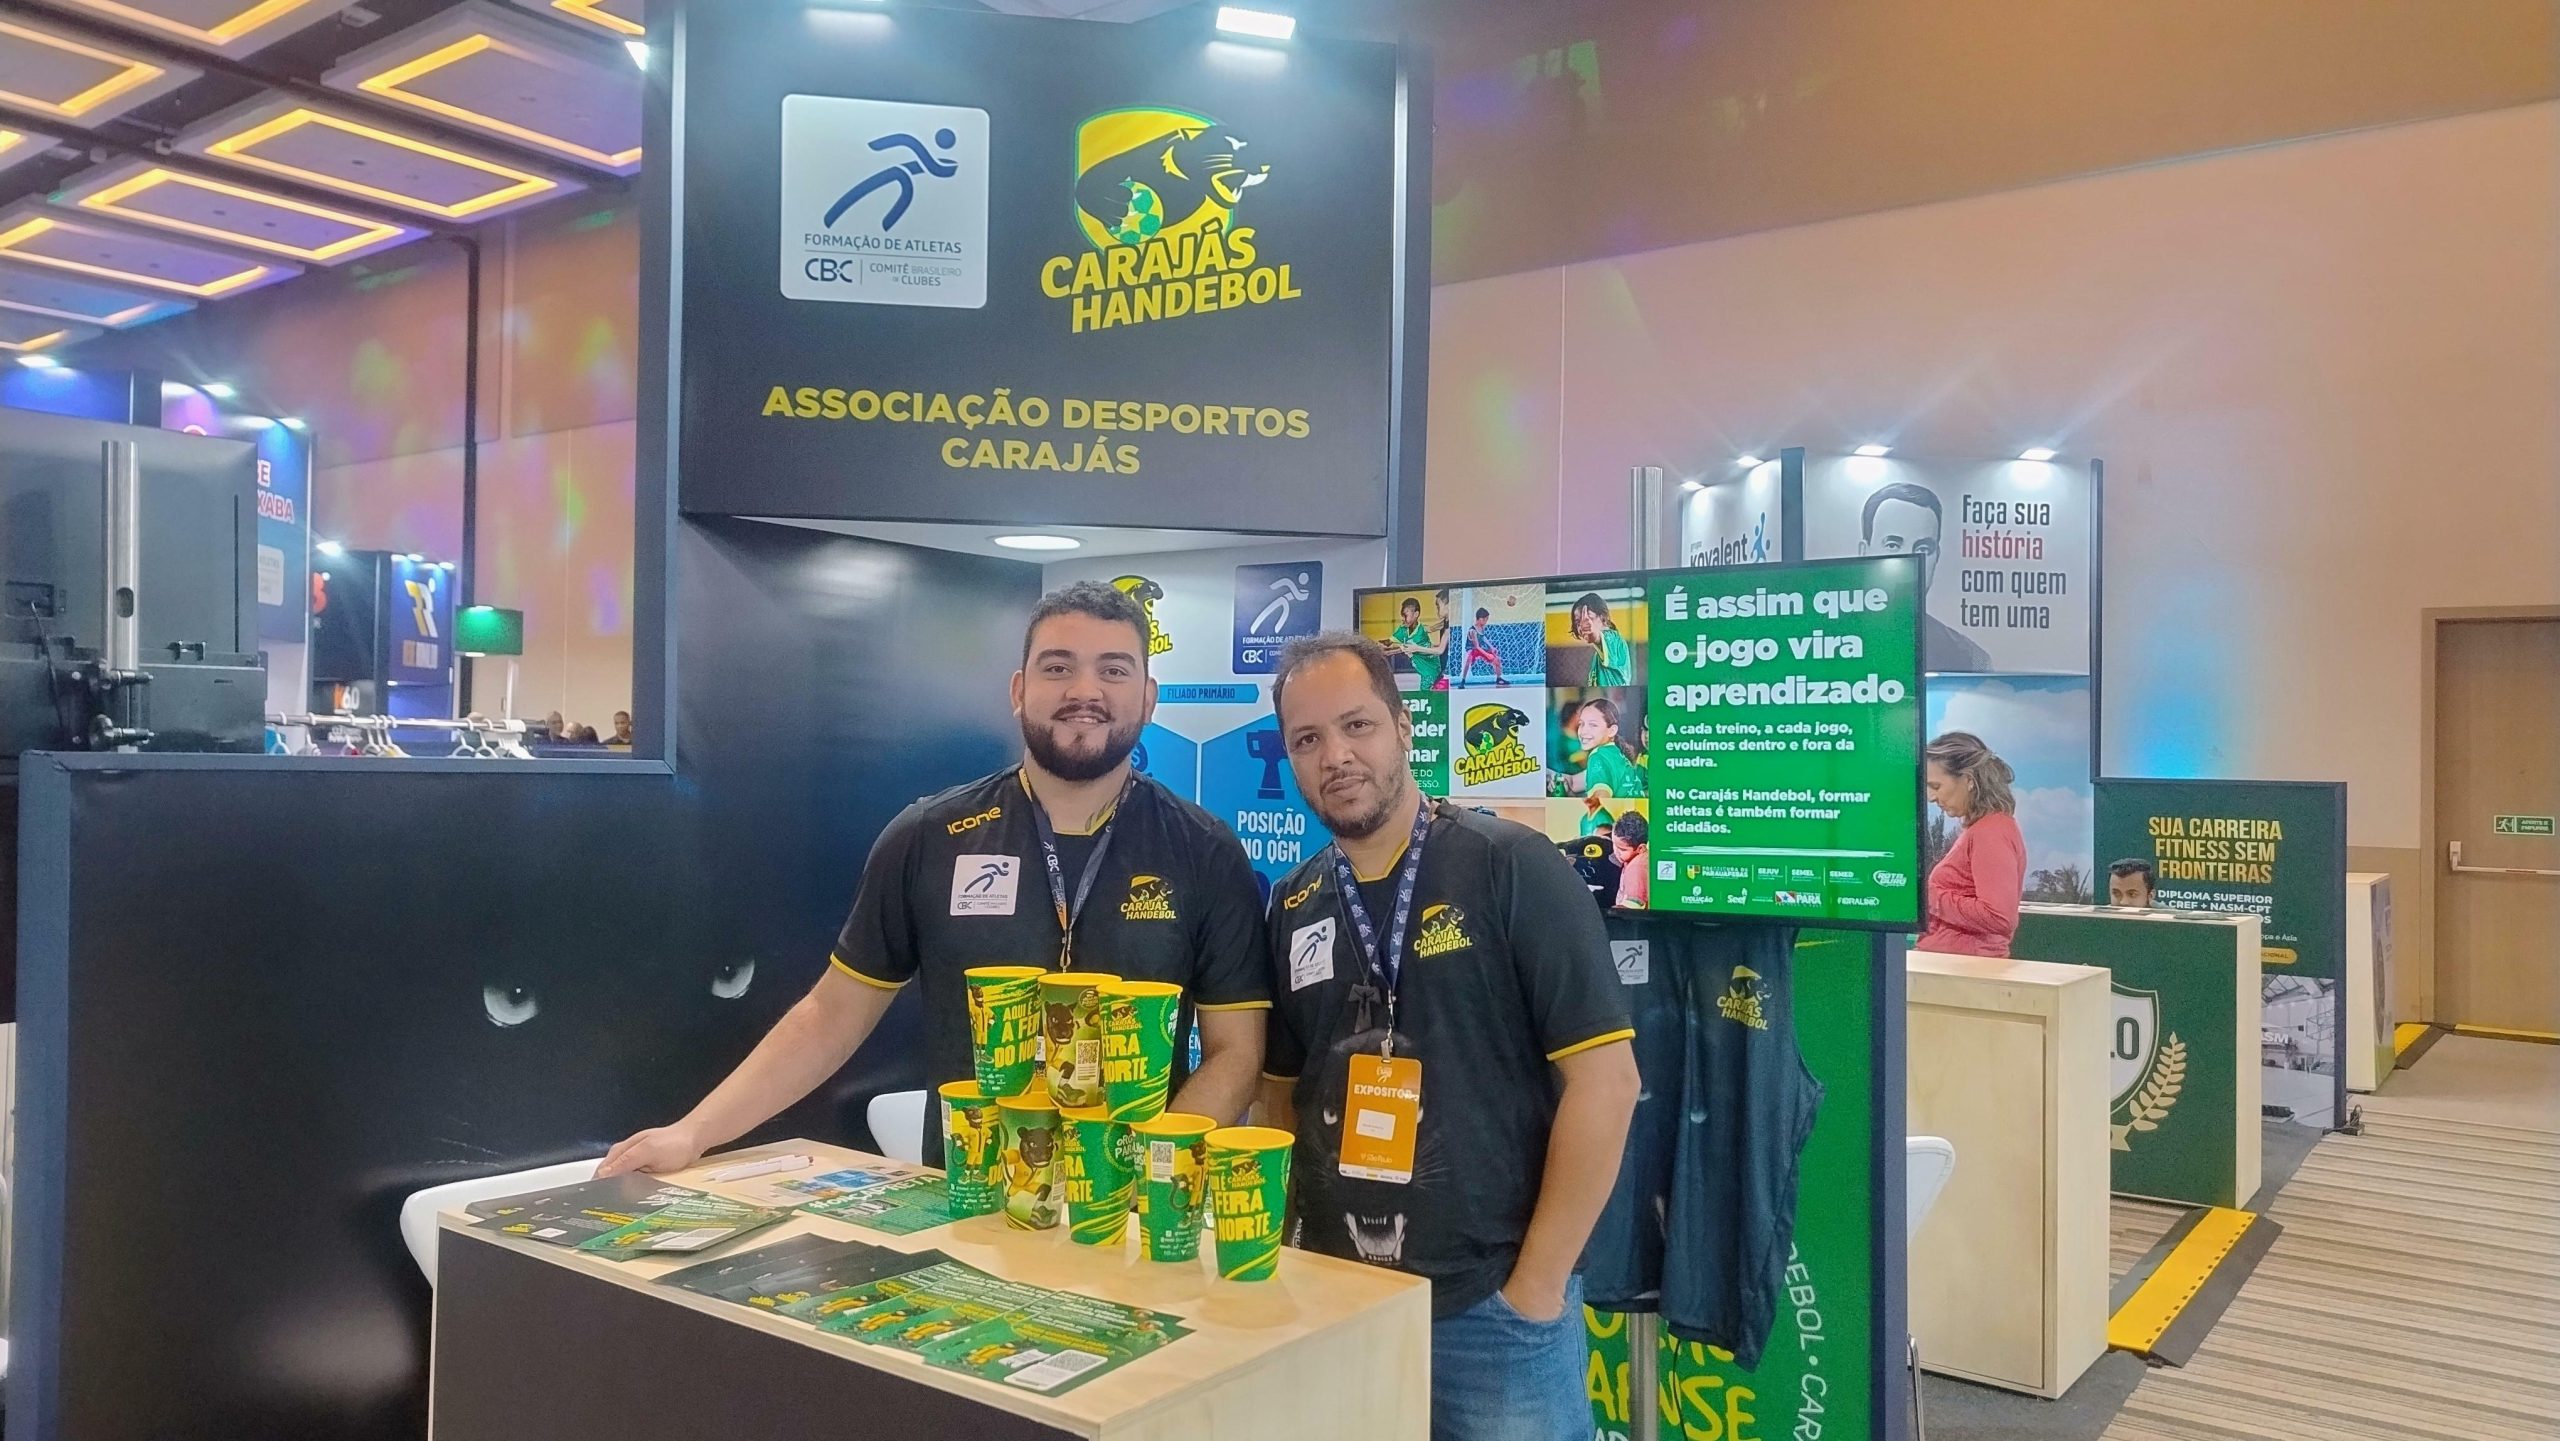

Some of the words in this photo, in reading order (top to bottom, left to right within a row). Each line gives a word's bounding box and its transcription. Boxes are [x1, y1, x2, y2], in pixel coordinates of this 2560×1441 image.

[804, 233, 881, 251] FORMAÇÃO
[884, 238, 902, 251] DE
[904, 240, 962, 254] ATLETAS
[804, 257, 853, 284] CBC
[870, 263, 909, 275] COMITÊ
[911, 265, 962, 277] BRASILEIRO
[1040, 219, 1256, 299] CARAJÁS
[901, 275, 941, 287] CLUBES
[1071, 263, 1302, 334] HANDEBOL
[761, 387, 1050, 430] ASSOCIAÇÃO
[1062, 401, 1312, 439] DESPORTOS
[940, 436, 1141, 475] CARAJÁS
[1962, 494, 2007, 530] Faça
[2014, 502, 2051, 525] sua
[1962, 528, 2043, 560] história
[1961, 569, 2004, 593] com
[2011, 571, 2067, 599] quem
[1665, 585, 1689, 621] É
[1696, 587, 1804, 620] assim
[1813, 587, 1889, 620] que
[1960, 598, 2000, 627] tem
[2007, 605, 2050, 629] uma
[1275, 636, 1284, 644] DE
[1664, 641, 1688, 664] o
[1694, 634, 1779, 669] jogo
[1788, 629, 1864, 660] vira
[1242, 649, 1264, 664] CBC
[1167, 687, 1197, 699] FILIADO
[1198, 685, 1236, 700] PRIMÁRIO
[1664, 673, 1905, 713] aprendizado
[1665, 723, 1677, 735] A
[1679, 722, 1713, 735] cada
[1715, 722, 1762, 736] treino,
[1764, 725, 1774, 734] a
[1776, 722, 1812, 734] cada
[1814, 721, 1853, 736] jogo,
[1665, 738, 1736, 751] evoluímos
[1738, 739, 1787, 751] dentro
[1789, 741, 1799, 751] e
[1802, 738, 1832, 751] fora
[1835, 739, 1855, 751] da
[1455, 743, 1526, 776] CARAJÁS
[1464, 756, 1541, 788] HANDEBOL
[1665, 756, 1718, 769] quadra.
[1665, 788, 1686, 800] No
[1688, 788, 1740, 802] Carajás
[1742, 789, 1816, 804] Handebol,
[1818, 789, 1871, 803] formar
[1237, 807, 1306, 840] POSIÇÃO
[1665, 805, 1713, 817] atletas
[1715, 804, 1725, 817] é
[1727, 805, 1787, 819] também
[1789, 806, 1841, 820] formar
[1665, 820, 1732, 834] cidadãos.
[2148, 816, 2185, 836] SUA
[2189, 818, 2283, 841] CARREIRA
[1266, 839, 1301, 865] QGM
[2155, 838, 2230, 860] FITNESS
[2234, 841, 2276, 863] SEM
[2158, 859, 2273, 884] FRONTEIRAS
[2157, 889, 2212, 901] DIPLOMA
[2213, 892, 2273, 905] SUPERIOR
[2168, 900, 2198, 910] CREF
[2209, 902, 2272, 914] NASM-CPT
[1126, 910, 1177, 920] HANDEBOL
[1419, 936, 1473, 960] HANDEBOL
[1001, 1021, 1015, 1044] A
[994, 1044, 1016, 1069] DO
[1214, 1187, 1264, 1215] FERA
[1217, 1211, 1272, 1242] NORTE
